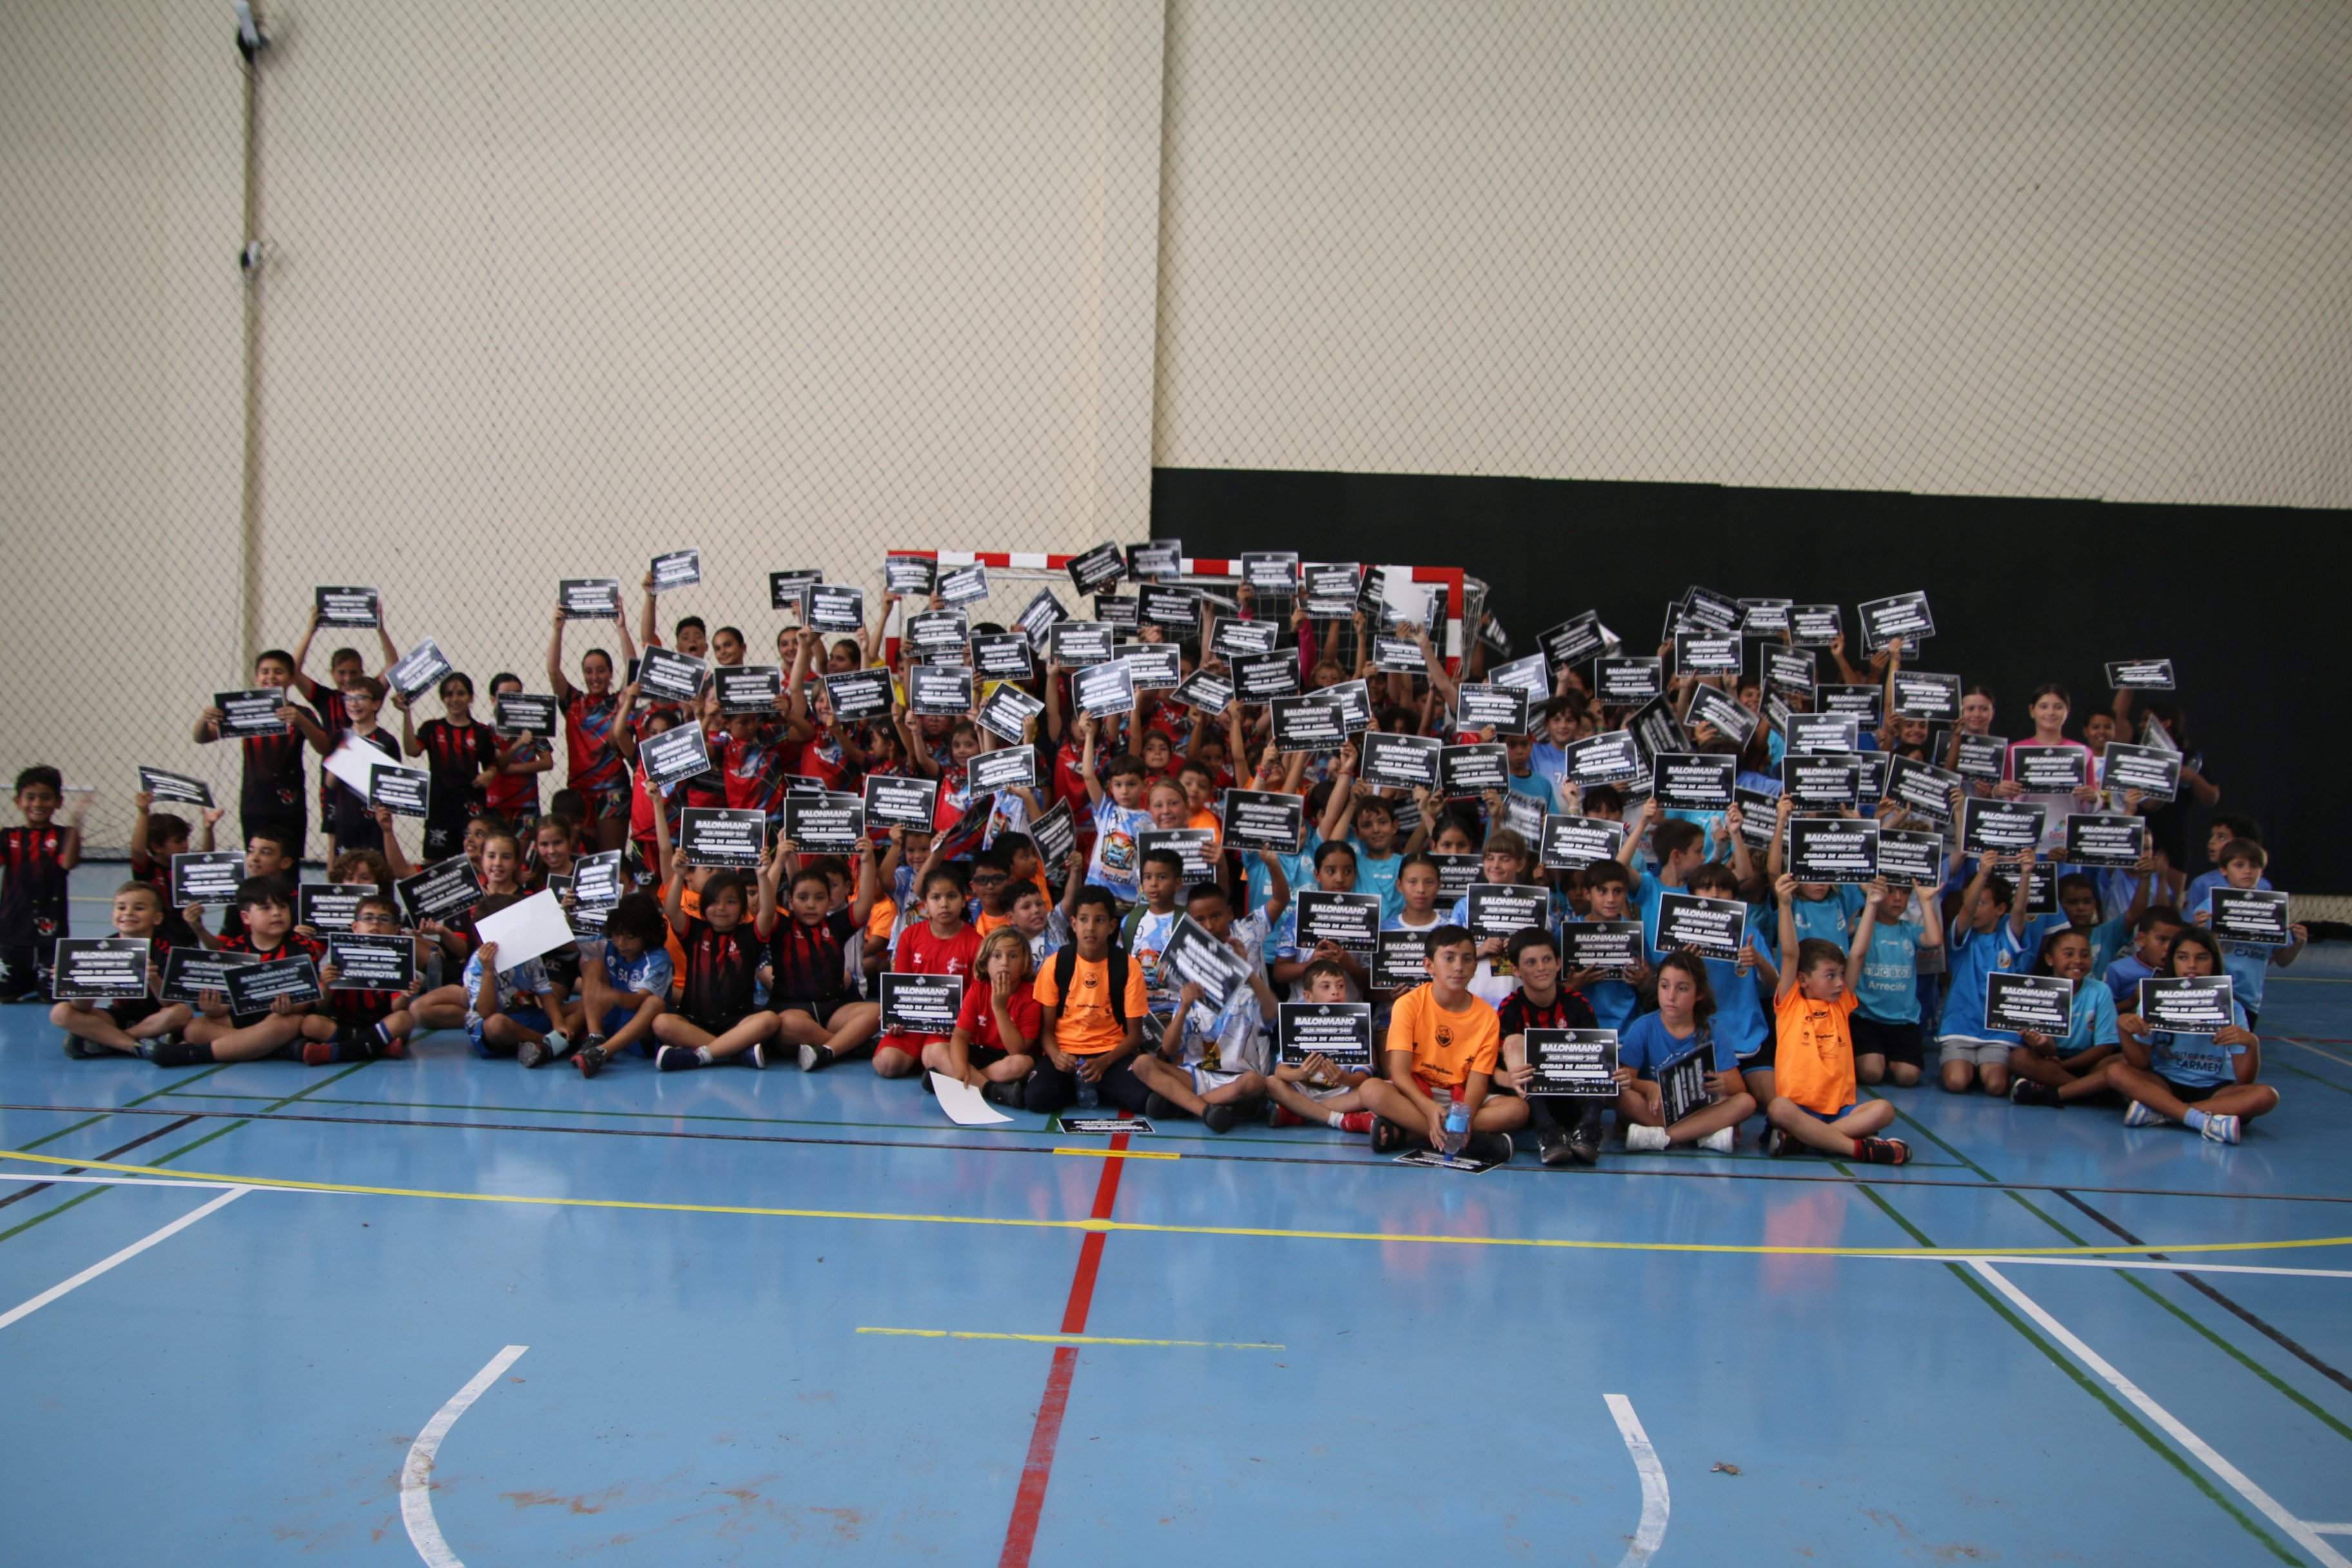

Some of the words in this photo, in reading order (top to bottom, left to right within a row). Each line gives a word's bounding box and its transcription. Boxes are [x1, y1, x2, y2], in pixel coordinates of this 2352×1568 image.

[1283, 707, 1332, 717] BALONMANO
[1376, 744, 1428, 756] BALONMANO
[1667, 766, 1723, 775] BALONMANO
[876, 787, 924, 798] BALONMANO
[1237, 803, 1290, 815] BALONMANO
[1977, 810, 2034, 823] BALONMANO
[695, 820, 752, 830] BALONMANO
[2079, 825, 2132, 834] BALONMANO
[1555, 825, 1610, 838] BALONMANO
[1804, 833, 1865, 843] BALONMANO
[1440, 867, 1480, 875] ONMANO
[412, 868, 462, 896] BALONMANO
[1479, 896, 1536, 907] BALONMANO
[2223, 899, 2275, 910] BALONMANO
[1310, 904, 1367, 915] BALONMANO
[1672, 906, 1731, 922] BALONMANO
[1384, 943, 1425, 951] BALONM
[894, 986, 949, 995] BALONMANO
[1868, 980, 1906, 992] Arrecife
[2000, 986, 2058, 999] BALONMANO
[2156, 989, 2218, 998] BALONMANO
[1294, 1017, 1356, 1025] BALONMANO
[1540, 1043, 1603, 1052] BALONMANO
